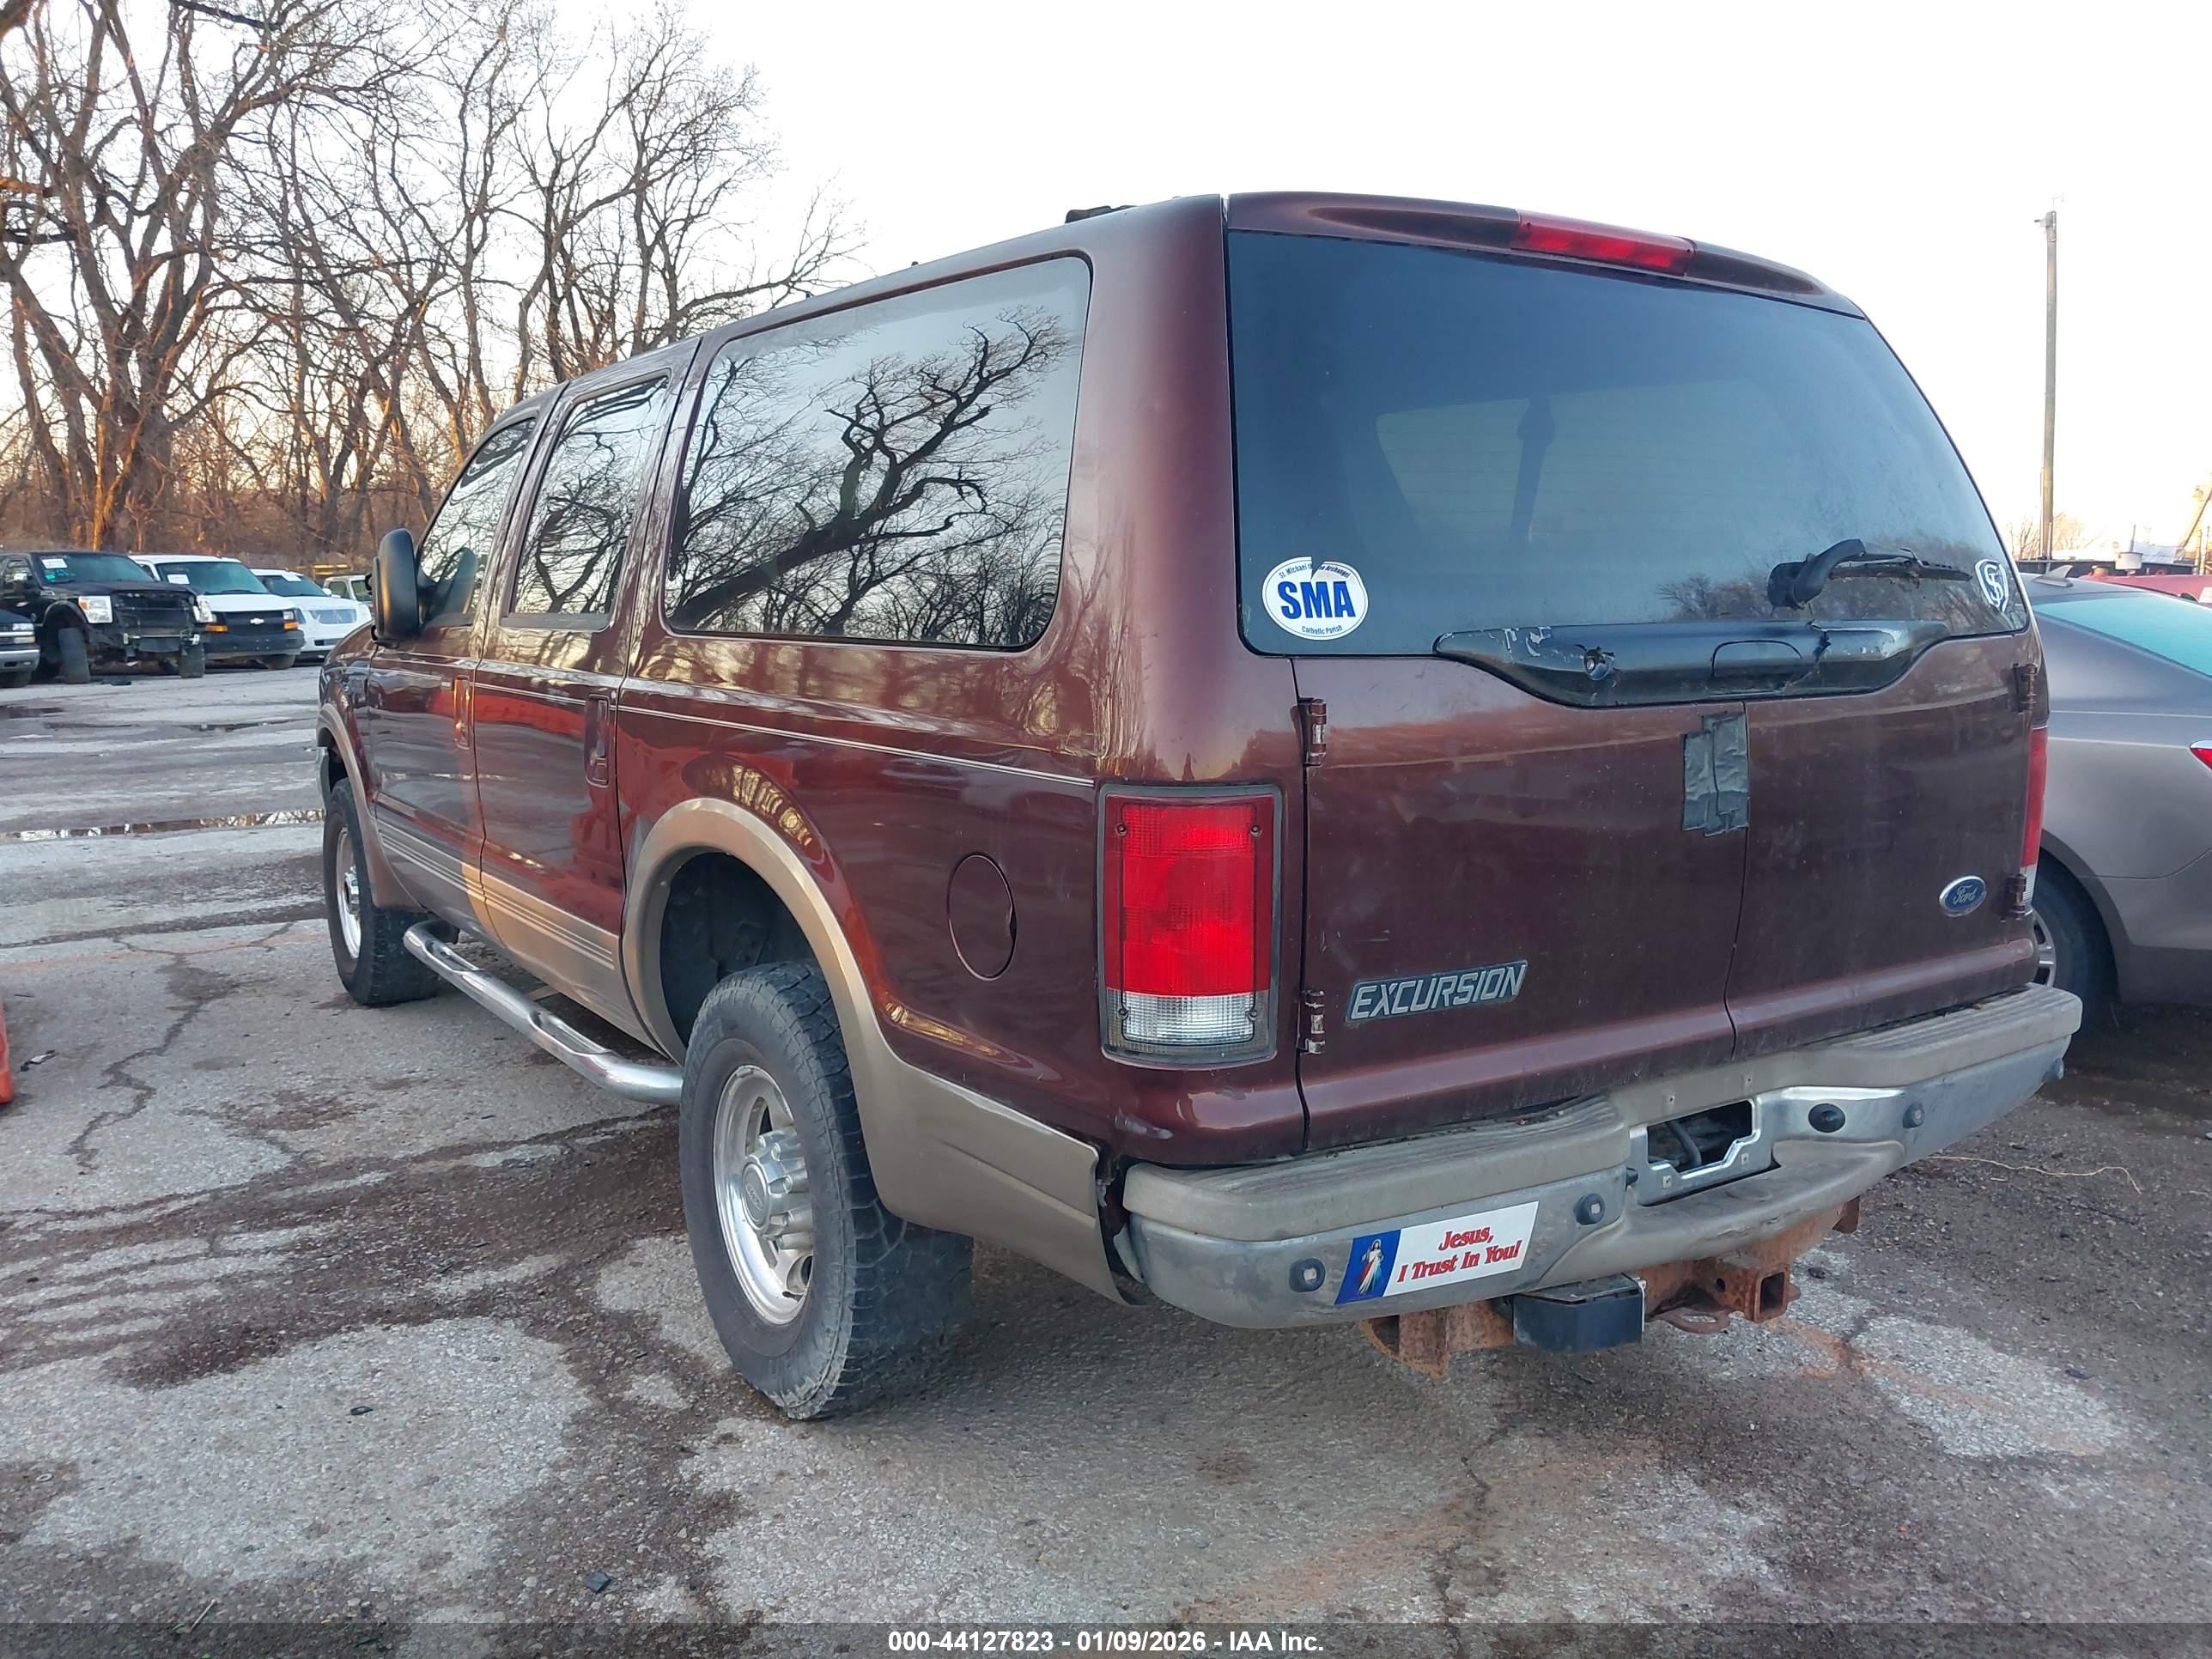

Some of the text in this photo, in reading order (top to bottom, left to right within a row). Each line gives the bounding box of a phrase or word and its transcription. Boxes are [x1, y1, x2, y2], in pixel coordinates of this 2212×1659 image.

[1286, 563, 1307, 575] Michael
[1325, 565, 1352, 579] Archangel
[1277, 580, 1356, 620] SMA
[1302, 624, 1343, 635] Catholic Parish
[1953, 884, 1978, 905] Ford
[1351, 964, 1527, 1020] EXCURSION
[1437, 1226, 1494, 1251] Jesus,
[1397, 1239, 1522, 1283] I Trust In You!
